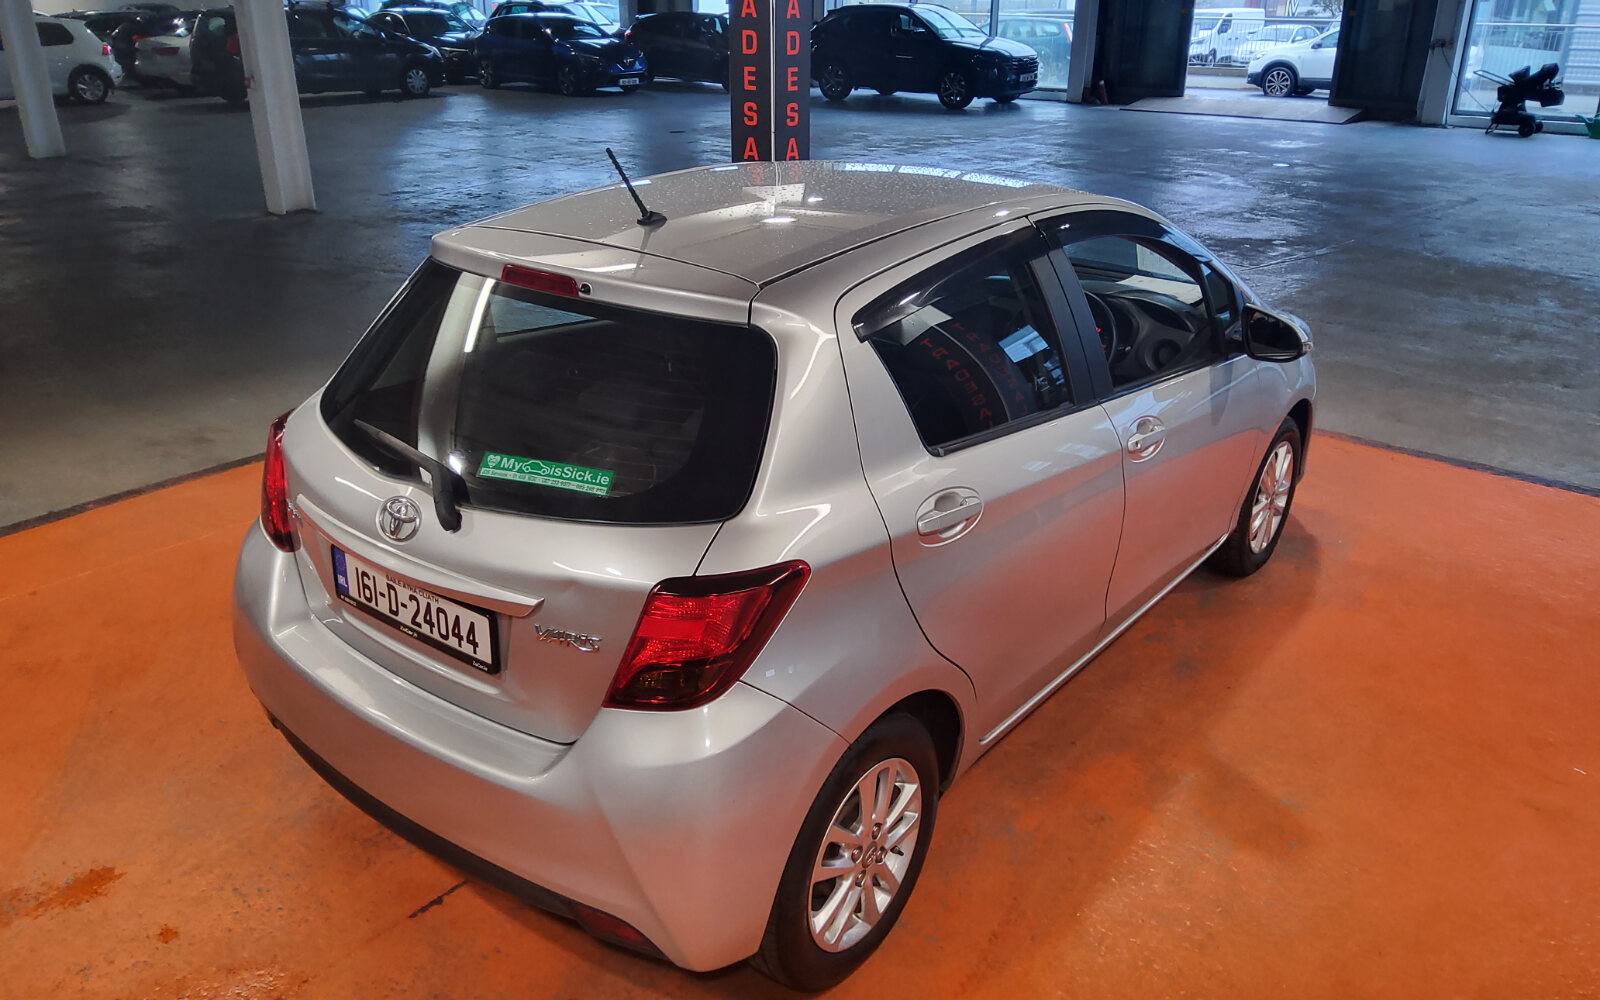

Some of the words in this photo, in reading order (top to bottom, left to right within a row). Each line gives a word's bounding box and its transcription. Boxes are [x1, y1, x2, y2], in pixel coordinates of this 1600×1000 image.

[500, 457, 523, 472] My
[550, 464, 610, 485] isSick.ie
[355, 566, 479, 655] 161-D-24044
